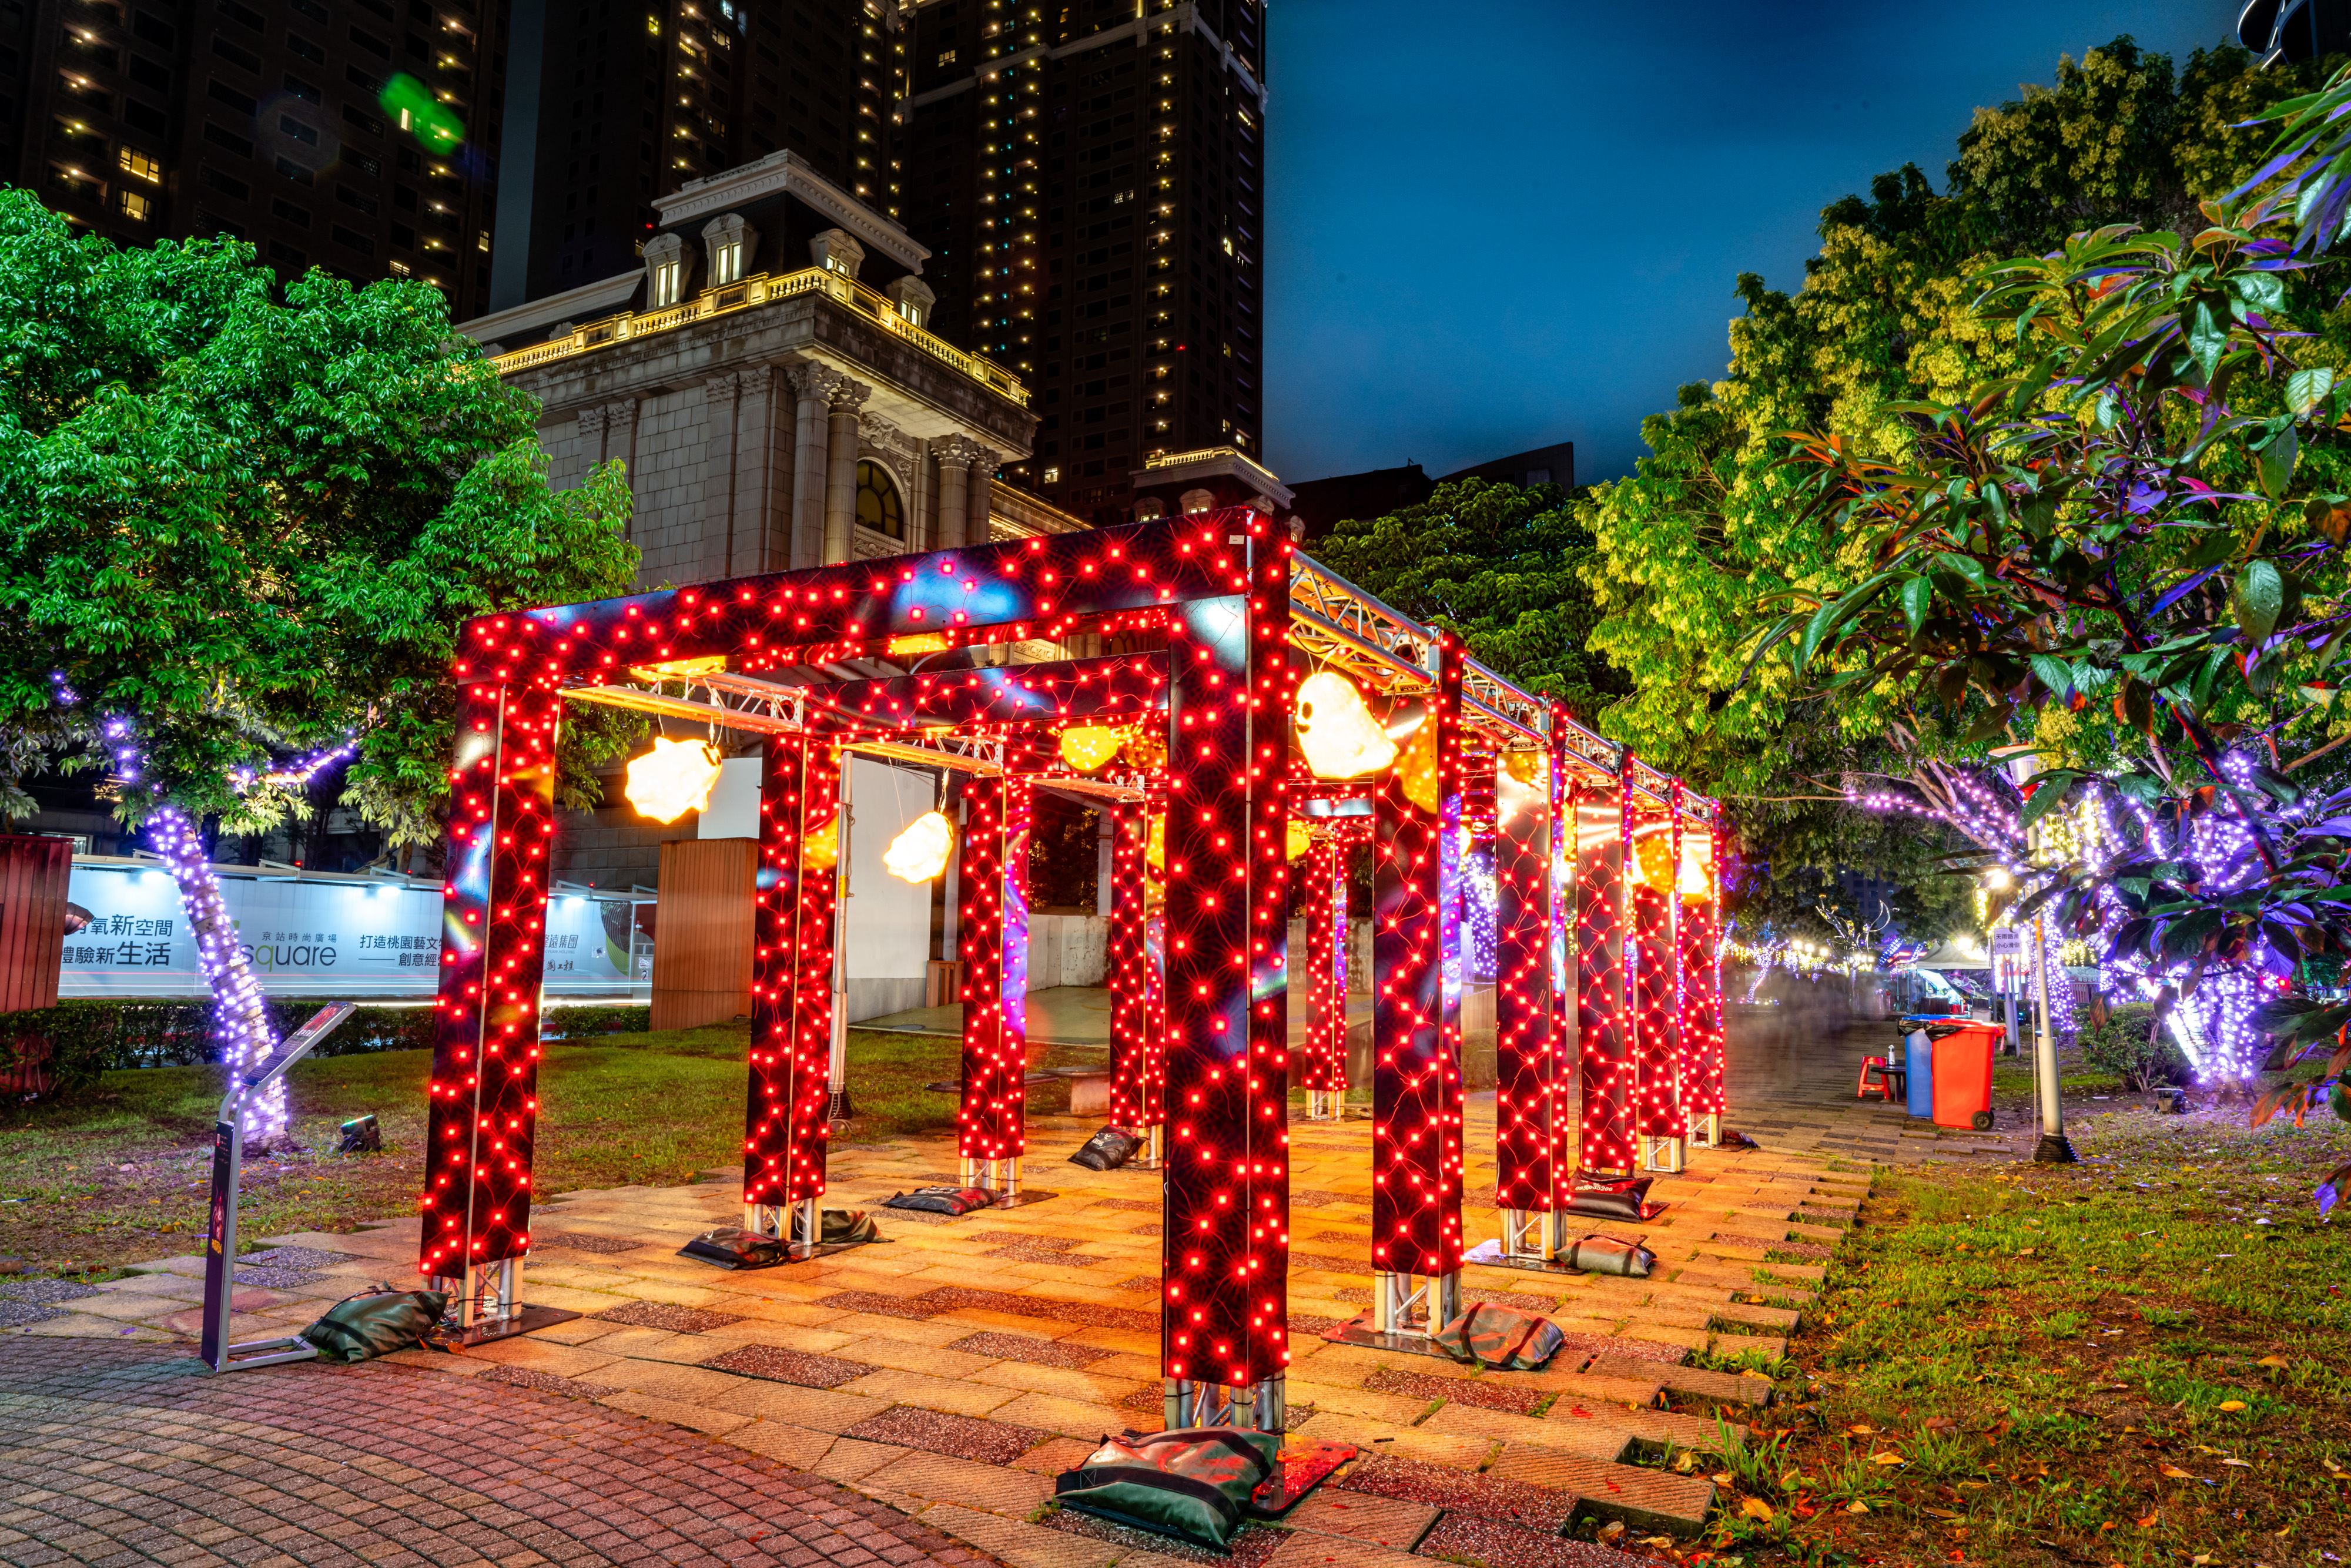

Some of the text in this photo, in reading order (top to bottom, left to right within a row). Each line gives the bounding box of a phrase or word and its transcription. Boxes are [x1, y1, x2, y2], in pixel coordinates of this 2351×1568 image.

[262, 932, 337, 943] 京站時尚廣場
[359, 934, 442, 950] 打造桃園藝文
[240, 944, 337, 972] square
[642, 970, 647, 981] 2
